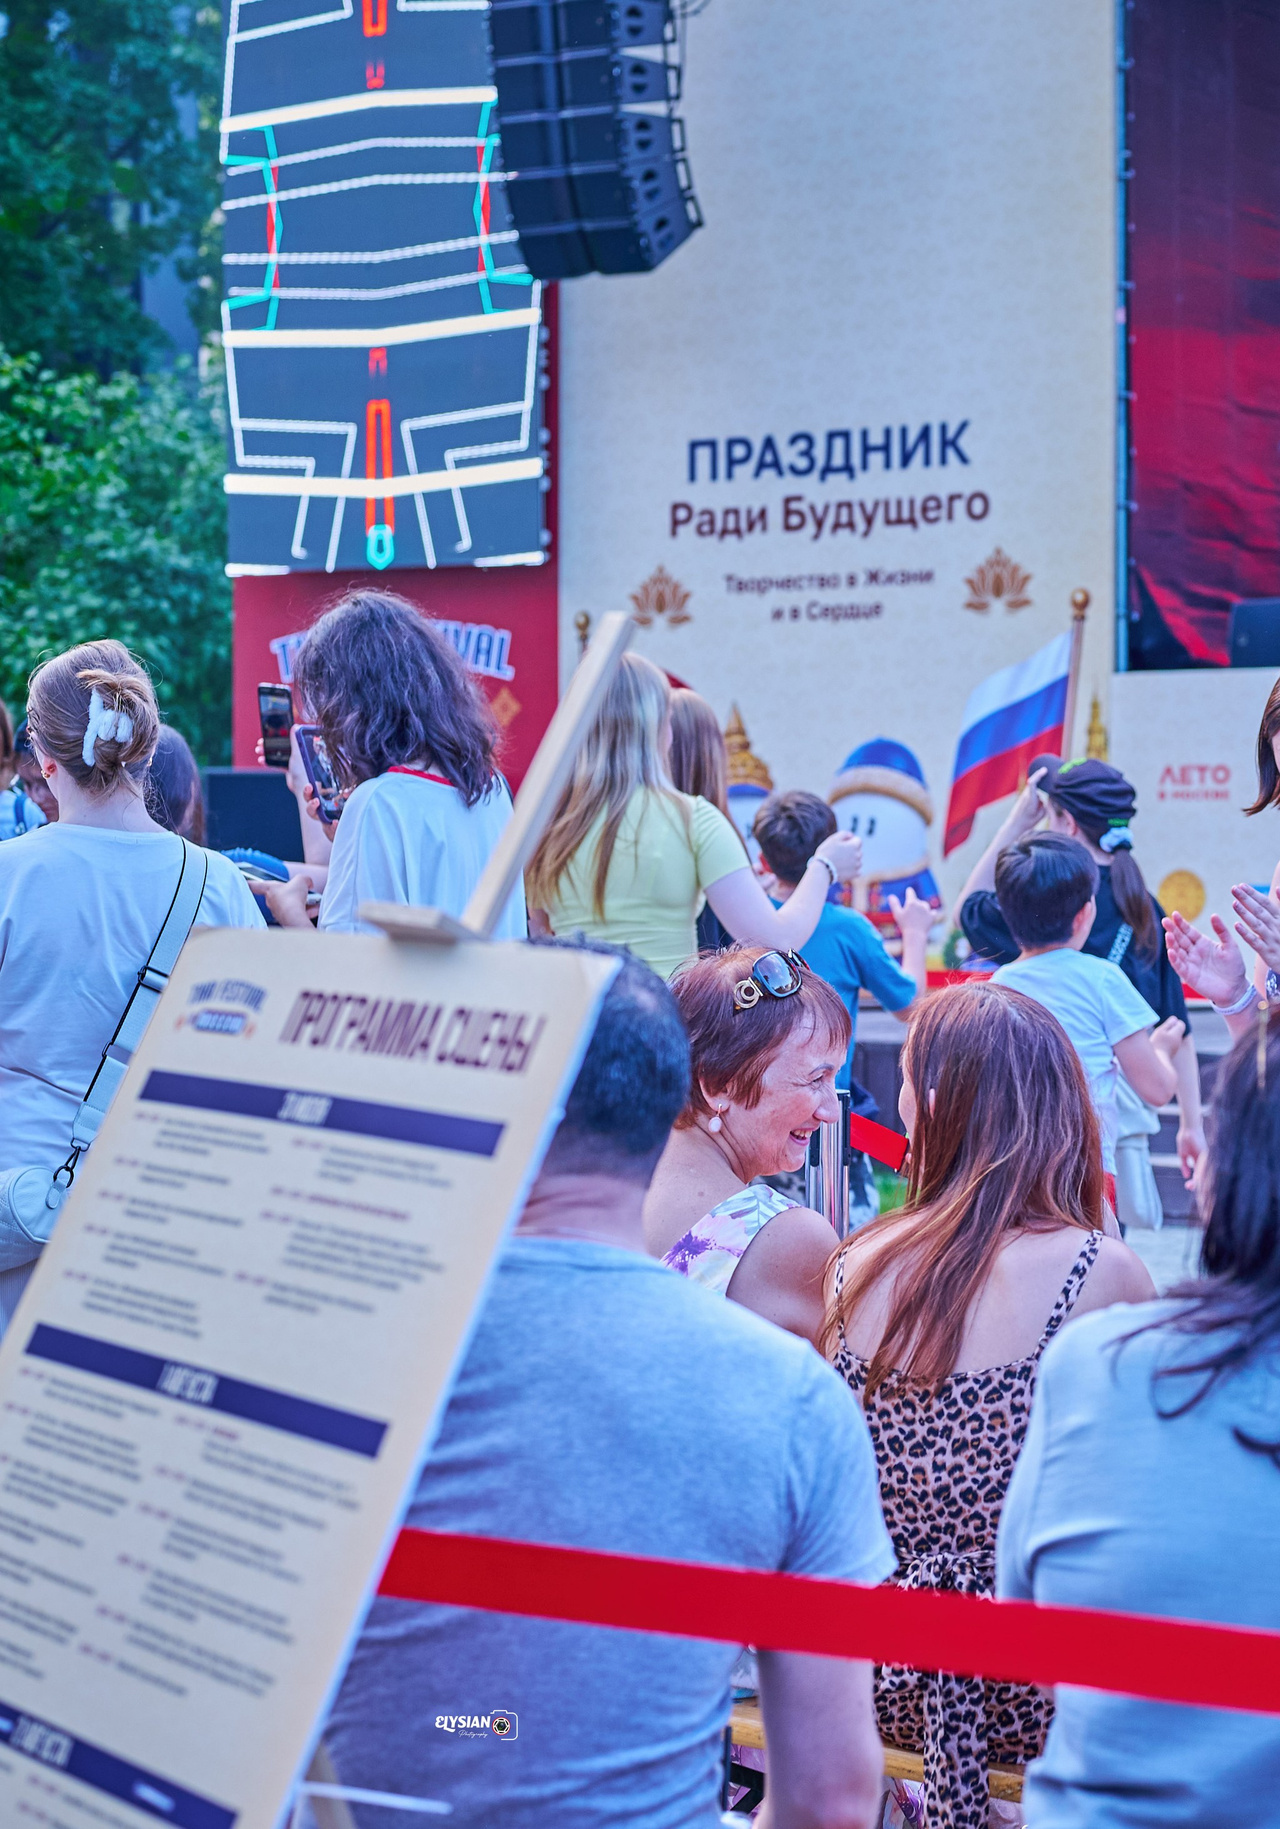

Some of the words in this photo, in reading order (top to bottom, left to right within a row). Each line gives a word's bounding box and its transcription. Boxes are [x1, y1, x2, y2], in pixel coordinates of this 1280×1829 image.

[688, 419, 971, 484] ПРАЗДНИК
[669, 502, 768, 542] Ради
[781, 491, 991, 542] Будущего
[724, 573, 841, 596] Творчество
[846, 573, 857, 587] в
[864, 568, 935, 586] Жизни
[806, 601, 883, 624] Сердце
[1158, 763, 1231, 786] ЛЕТО
